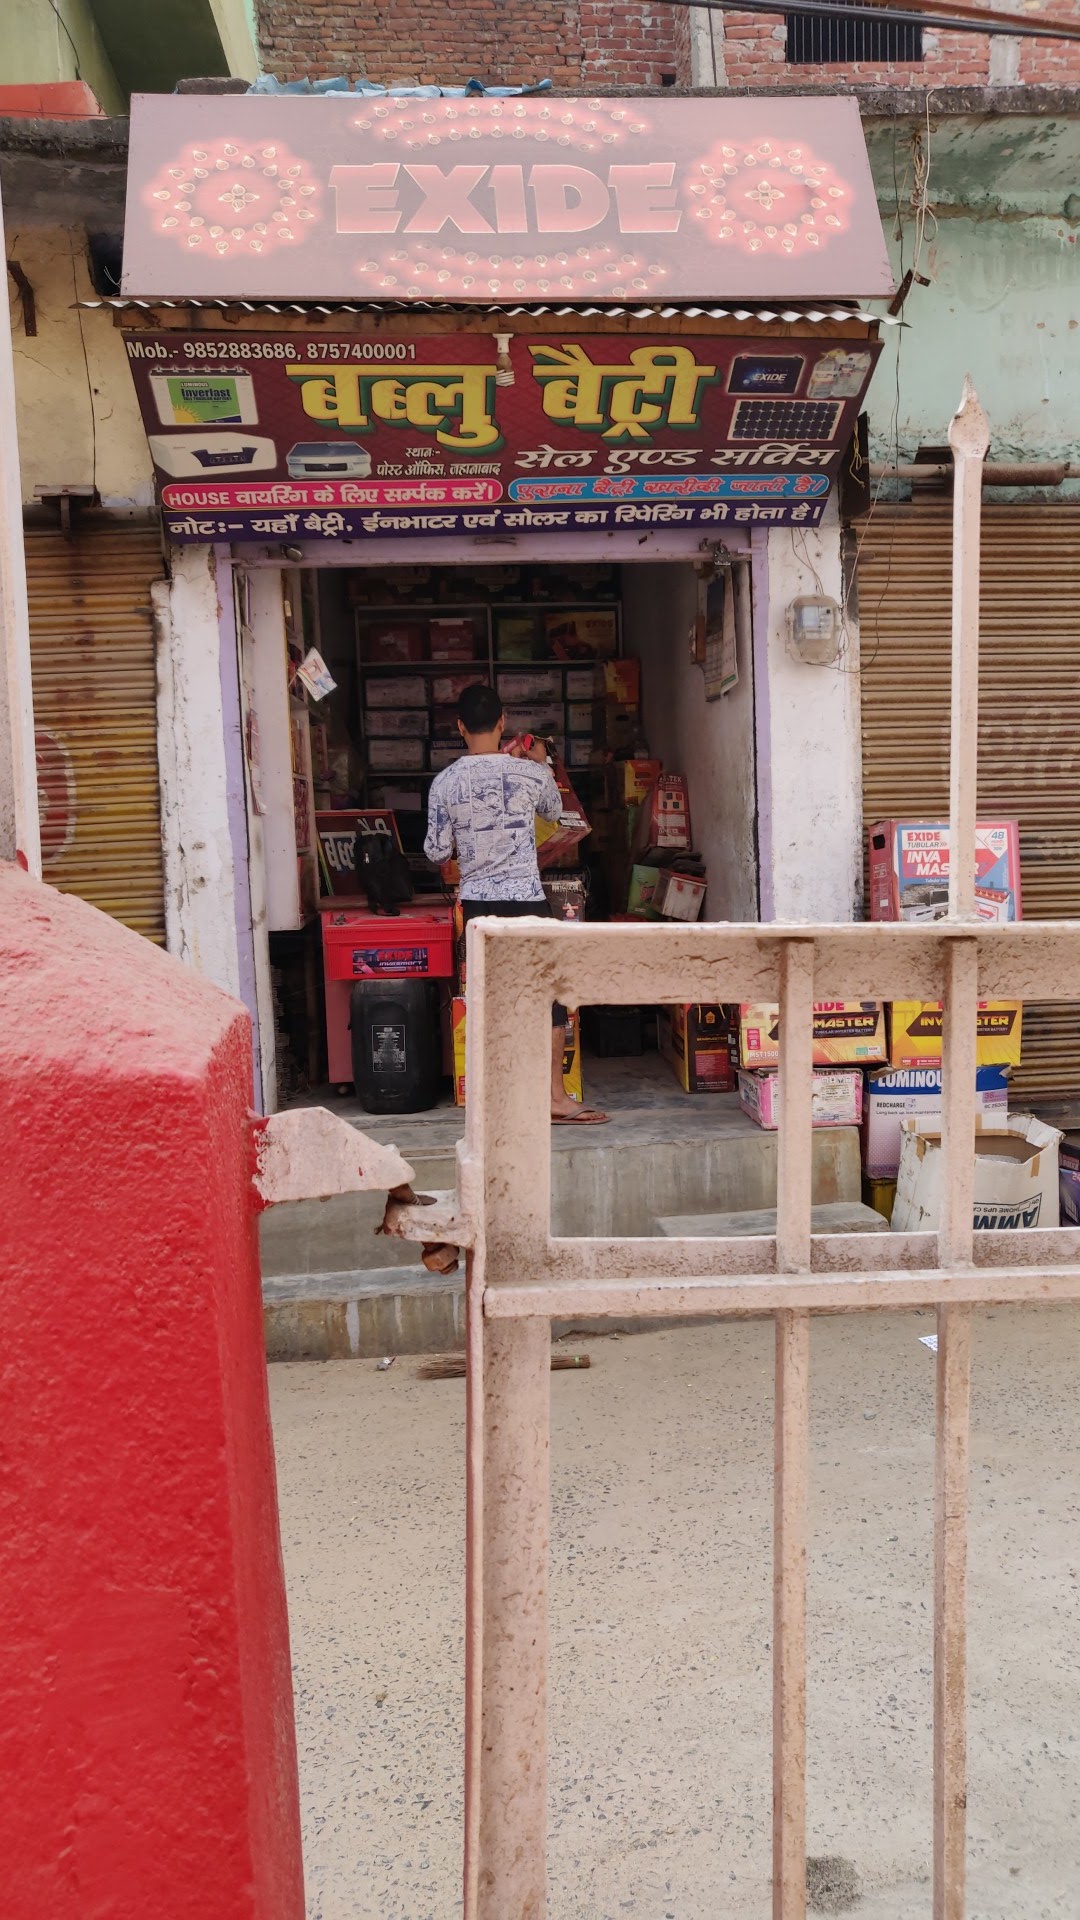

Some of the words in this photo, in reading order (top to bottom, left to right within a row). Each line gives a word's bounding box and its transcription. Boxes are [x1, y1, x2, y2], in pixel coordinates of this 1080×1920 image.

[328, 162, 682, 234] EXIDE
[126, 342, 178, 359] Mob.-
[183, 342, 302, 360] 9852883686,
[307, 343, 416, 359] 8757400001
[752, 373, 787, 382] EXIDE
[527, 344, 717, 437] बैट्री
[514, 443, 598, 469] सेल
[603, 449, 703, 474] एण्ड
[710, 442, 840, 466] सर्विस
[377, 460, 403, 476] पोस्ट
[404, 460, 446, 477] ऑफिस,
[449, 462, 501, 476] जहानाबाद
[168, 492, 231, 506] HOUSE
[234, 485, 308, 505] वायरिंग
[312, 485, 335, 503] के
[340, 483, 379, 503] लिए
[516, 482, 587, 501] पुराना
[592, 477, 638, 497] बैट्री
[643, 477, 725, 495] खरीदी
[730, 475, 790, 492] जाती
[250, 513, 300, 534] यहाँ
[462, 509, 501, 527] एवं
[503, 508, 571, 527] सोलर
[575, 510, 609, 524] का
[614, 504, 695, 523] रिपेरिंग
[700, 503, 731, 521] भी
[734, 505, 787, 522] होता
[907, 832, 940, 841] EXIDE
[991, 831, 1005, 839] 48
[907, 851, 940, 863] INVA
[377, 950, 413, 961] EXIDE
[813, 1002, 845, 1012] IDE
[877, 1070, 942, 1088] LUMINOU
